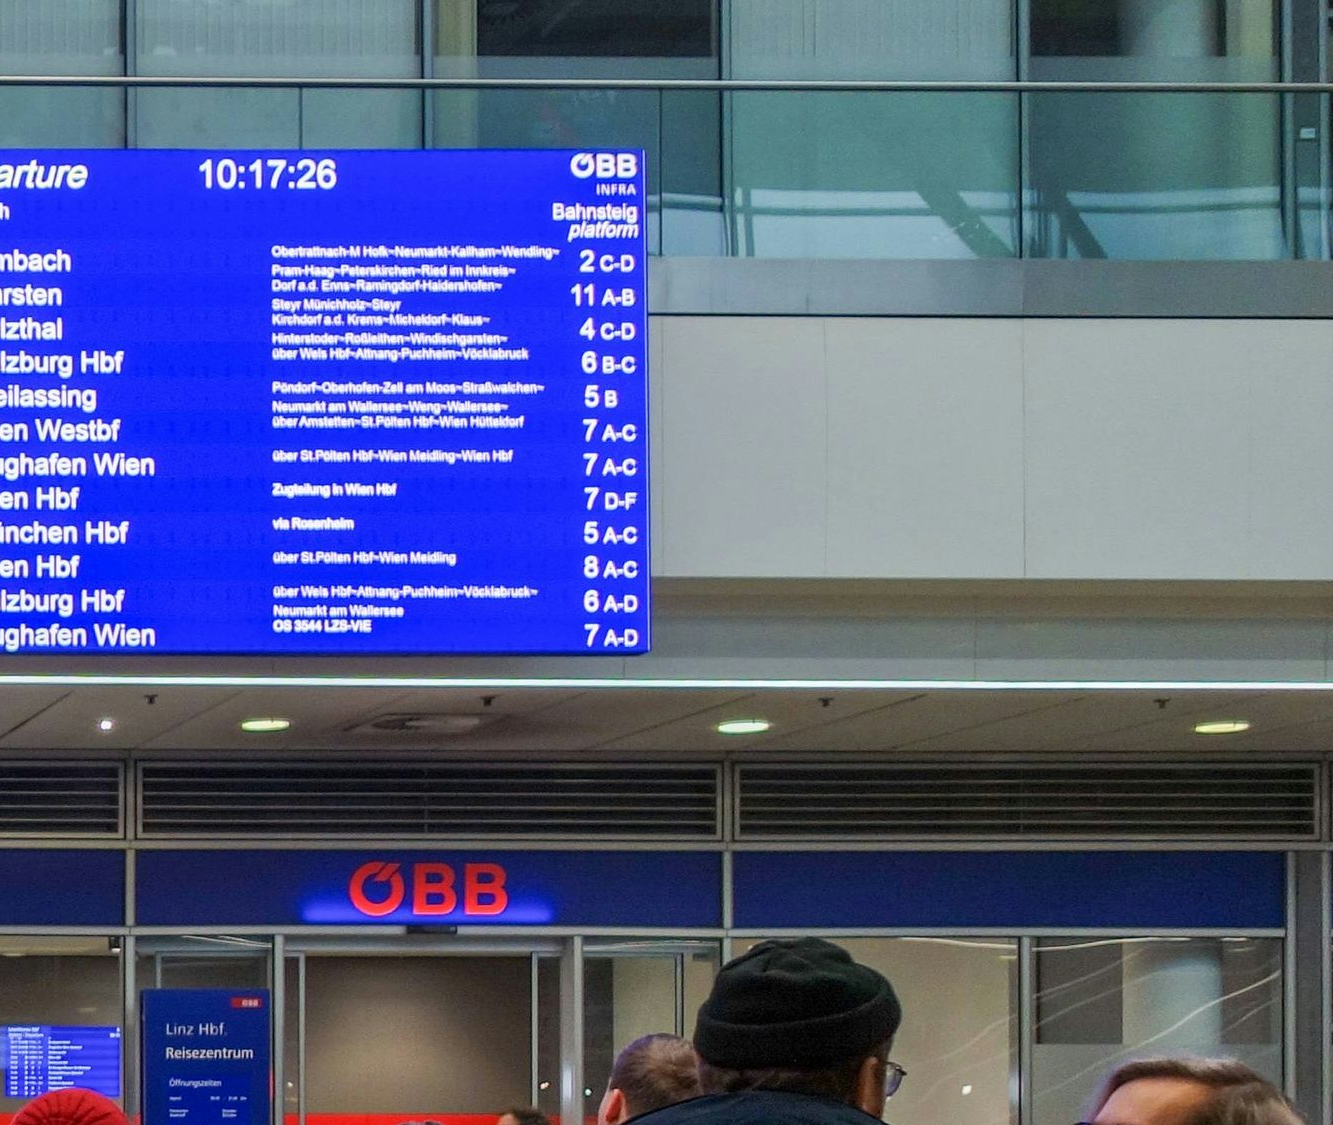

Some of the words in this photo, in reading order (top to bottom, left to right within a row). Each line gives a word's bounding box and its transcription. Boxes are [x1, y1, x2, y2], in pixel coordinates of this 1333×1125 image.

[199, 159, 336, 189] 10:17:26
[571, 153, 637, 178] ÖBB
[597, 185, 637, 196] INFRA
[345, 483, 374, 496] Wien
[376, 483, 397, 496] Hbf
[86, 521, 129, 544] Hbf
[348, 860, 508, 917] ÖBB
[166, 1023, 194, 1036] Linz
[166, 1046, 254, 1059] Reisezentrum
